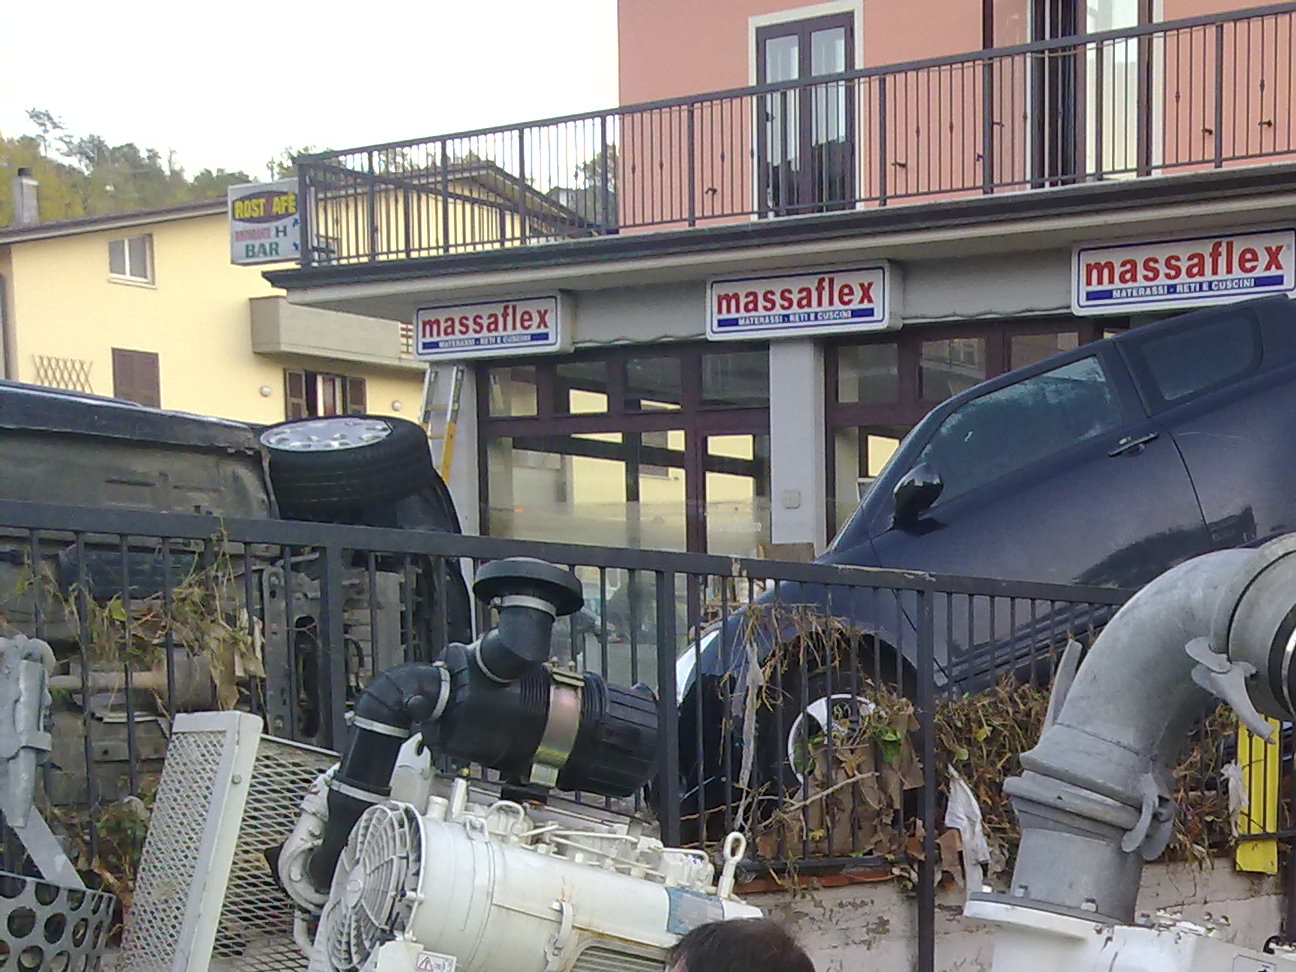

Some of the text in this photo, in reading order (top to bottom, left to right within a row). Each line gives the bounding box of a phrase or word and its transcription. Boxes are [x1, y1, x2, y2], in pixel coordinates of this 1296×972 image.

[245, 242, 280, 258] BAR
[1086, 241, 1284, 287] massaflex
[717, 277, 874, 315] massaflex
[1113, 278, 1254, 298] MATERASSI RETI E CUSCINI
[421, 304, 549, 339] massaflex
[738, 315, 783, 326] MATERASSI
